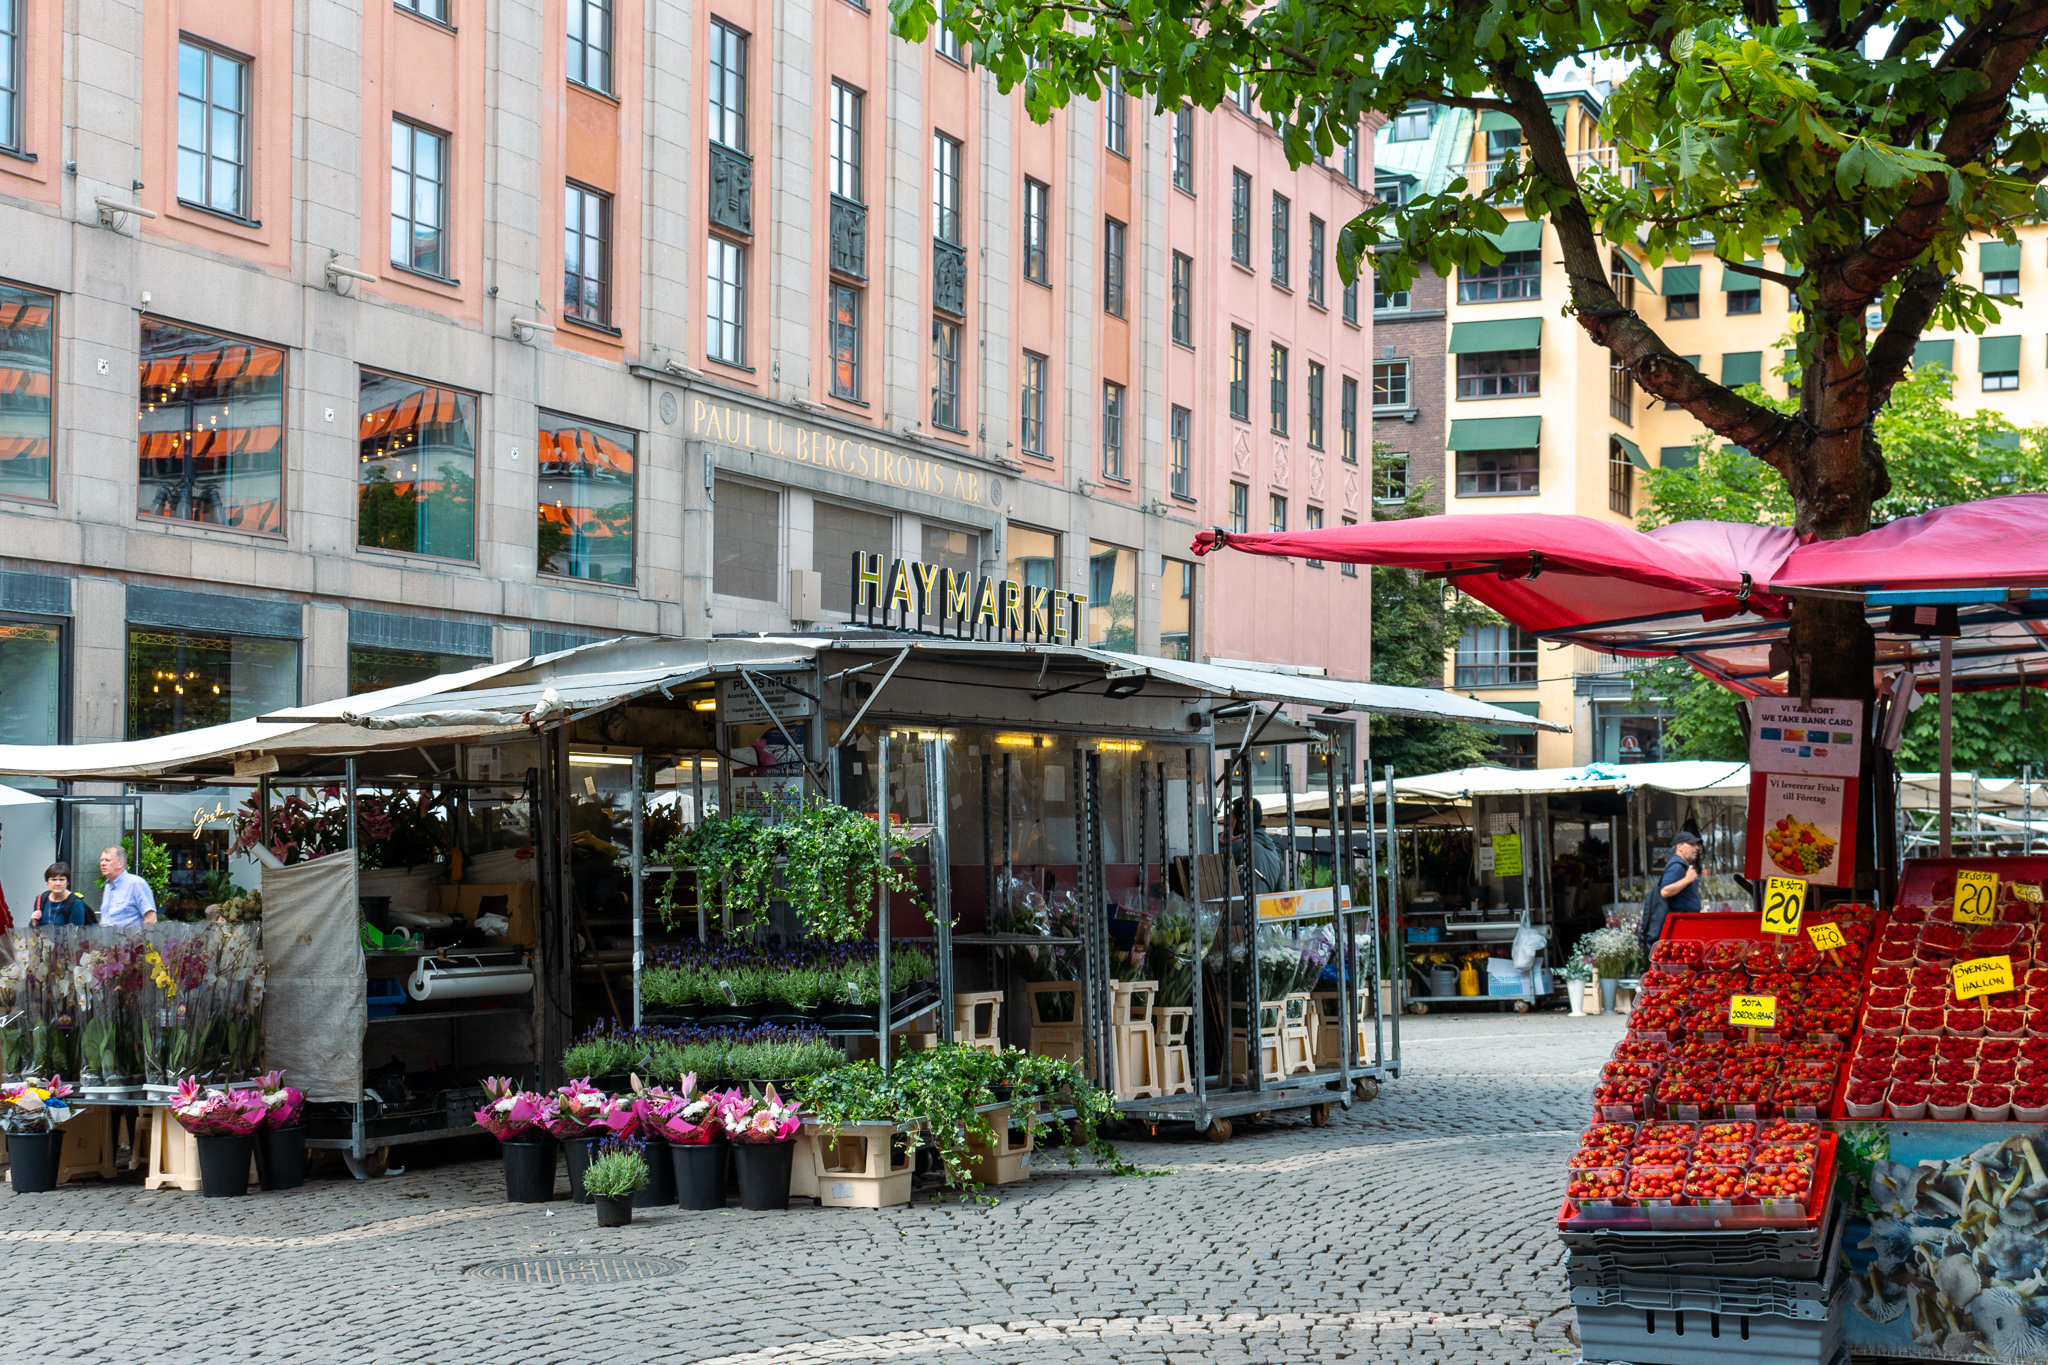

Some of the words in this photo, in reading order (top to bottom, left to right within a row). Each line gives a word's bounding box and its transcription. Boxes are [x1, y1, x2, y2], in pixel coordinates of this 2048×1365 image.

[694, 399, 756, 448] PAUL
[768, 419, 785, 455] U.
[797, 427, 944, 494] BERGSTRÖMS
[953, 469, 980, 503] A.B.
[852, 550, 1088, 642] HAYMARKET
[733, 678, 765, 691] PLTS
[1792, 705, 1809, 713] TA
[1811, 706, 1835, 715] KORT
[1761, 714, 1775, 722] WE
[1777, 715, 1800, 723] TAKE
[1801, 717, 1826, 725] BANK
[1828, 718, 1853, 727] CARD
[1770, 780, 1780, 788] Vi
[1781, 781, 1816, 790] levererar
[1817, 783, 1840, 792] Frukt
[1782, 792, 1794, 800] till
[1796, 793, 1826, 805] Företag
[1960, 883, 1993, 916] 20
[1765, 892, 1800, 925] 20
[1816, 931, 1839, 946] 40
[1955, 962, 2004, 978] SVENSKA
[1962, 976, 2005, 993] HALLON
